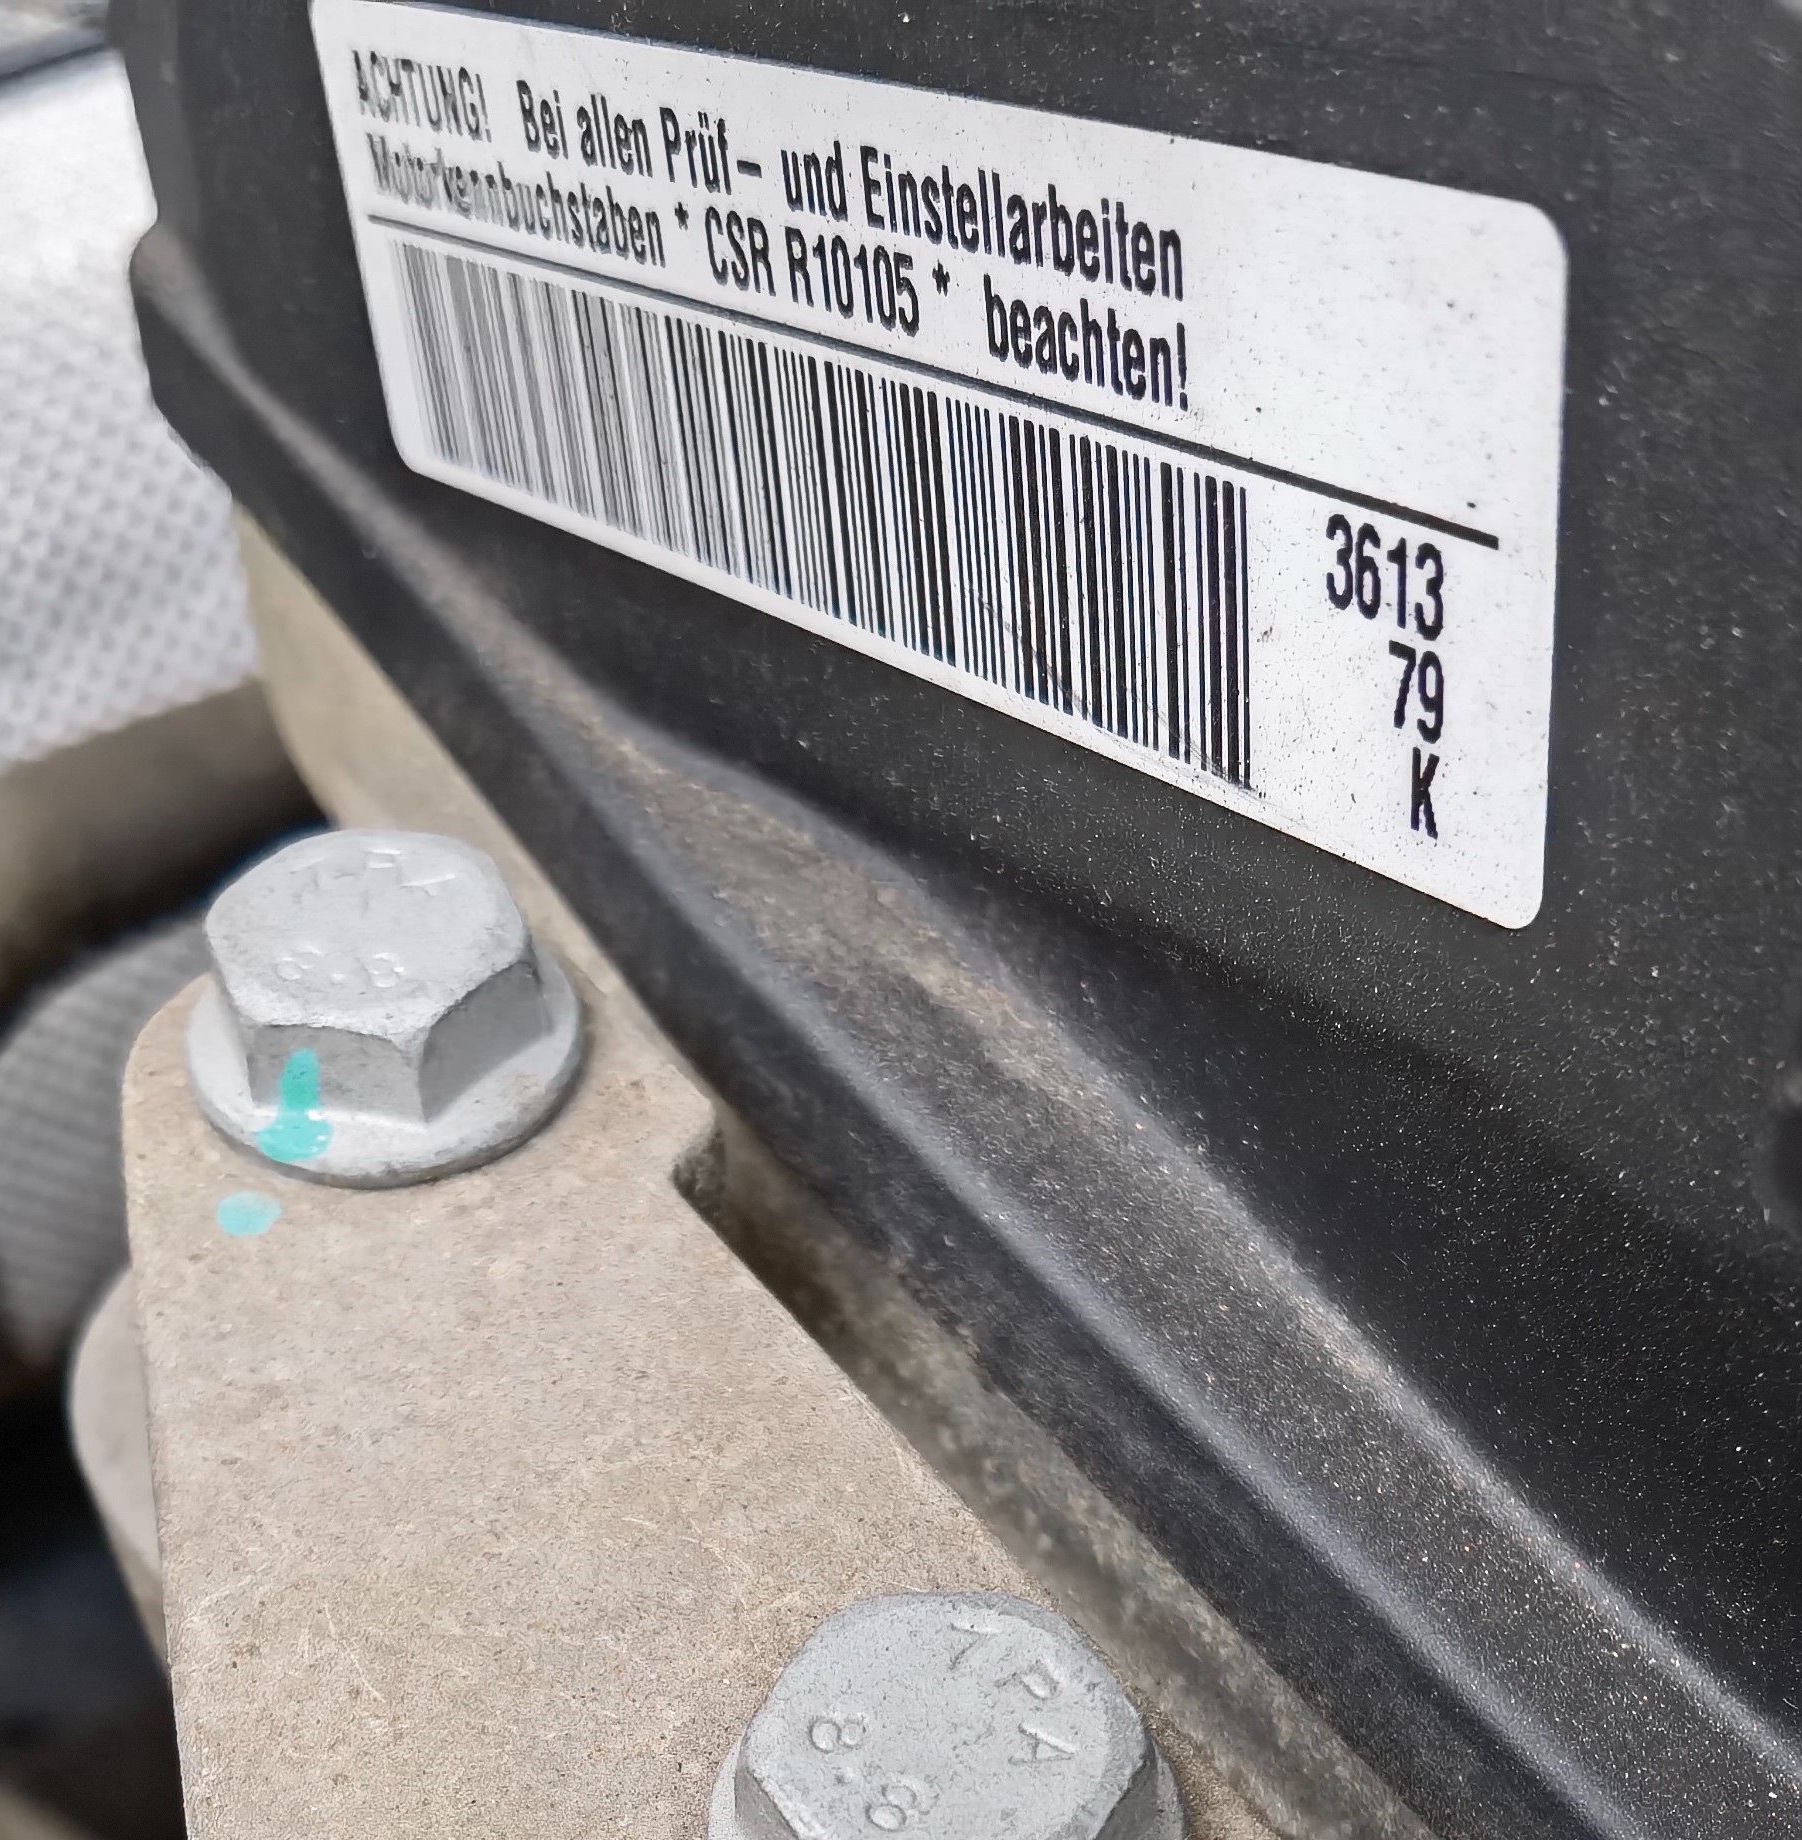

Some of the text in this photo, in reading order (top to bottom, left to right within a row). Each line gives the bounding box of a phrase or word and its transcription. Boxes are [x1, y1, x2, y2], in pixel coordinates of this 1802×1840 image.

[353, 49, 492, 143] ACHTUNG!
[516, 79, 569, 160] Bei
[577, 92, 653, 178] allen
[781, 140, 848, 223] und
[860, 143, 1184, 301] Einstellarbeiten
[704, 205, 777, 298] CSR
[785, 225, 921, 338] R10105
[983, 272, 1189, 412] beachten!
[1326, 513, 1445, 642] 3613
[1388, 639, 1445, 744] 79
[1410, 746, 1441, 840] K
